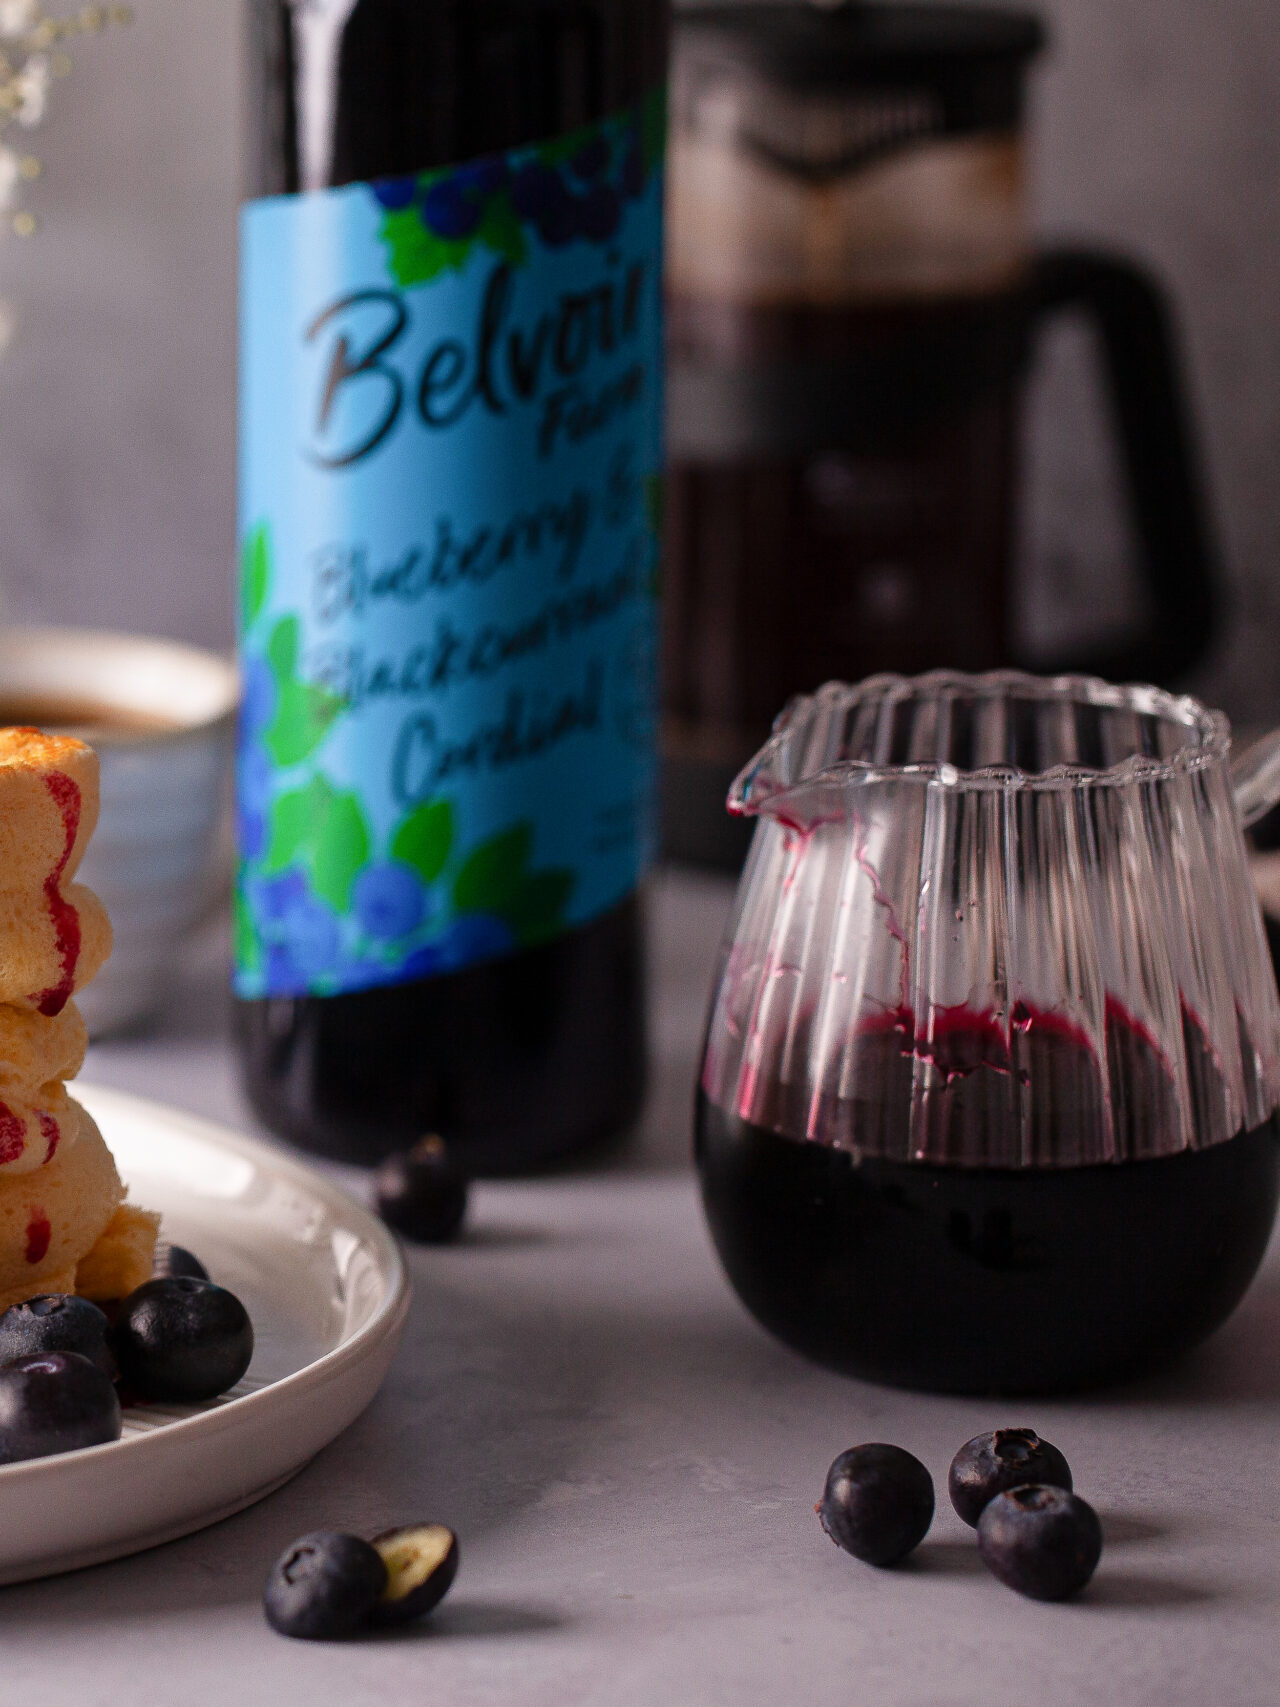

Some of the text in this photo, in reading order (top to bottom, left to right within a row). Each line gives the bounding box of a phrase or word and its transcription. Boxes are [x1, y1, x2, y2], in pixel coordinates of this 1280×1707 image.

[303, 252, 644, 472] Belvoir
[310, 487, 589, 625] Blueberry
[391, 657, 604, 811] Cordial
